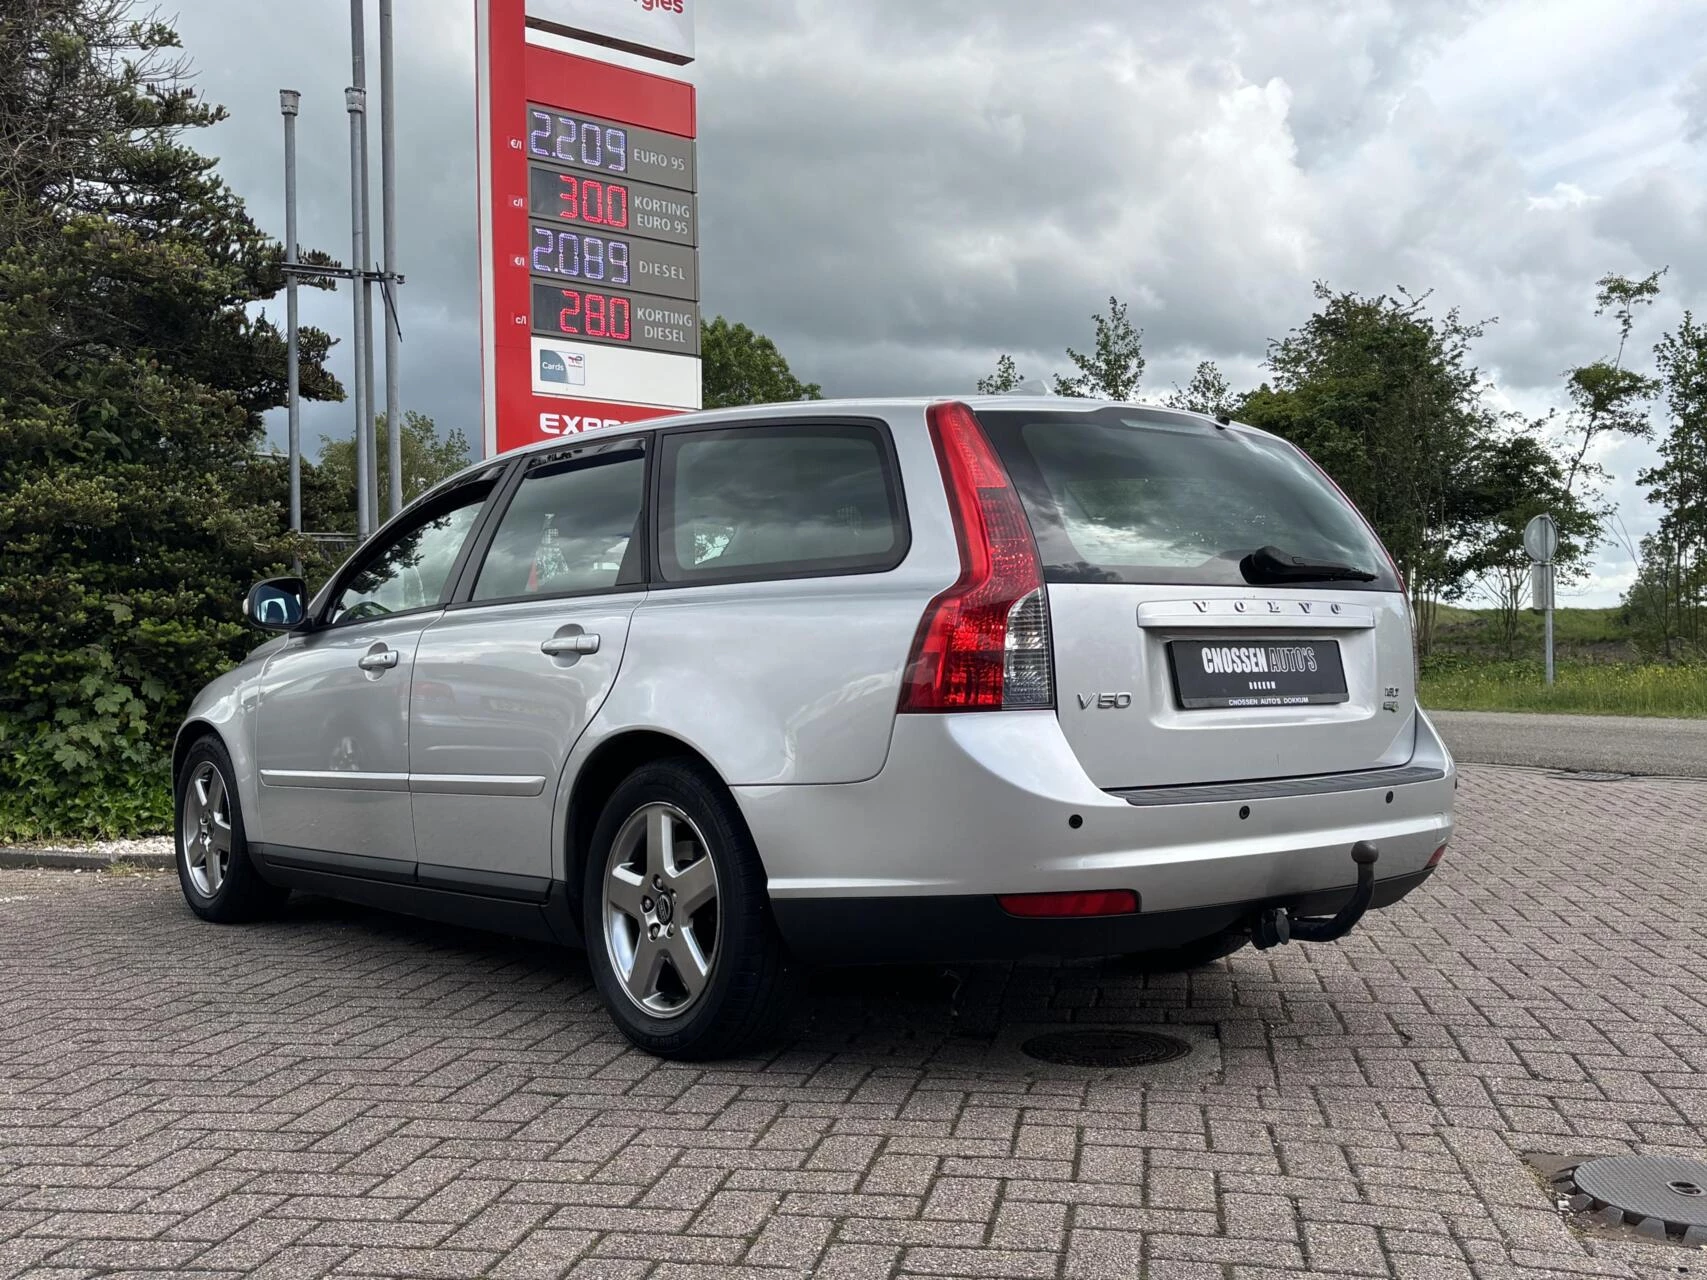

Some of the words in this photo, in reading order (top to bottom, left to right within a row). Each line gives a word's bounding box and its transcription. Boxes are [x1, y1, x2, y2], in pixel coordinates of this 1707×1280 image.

[530, 111, 626, 171] 2.209
[634, 149, 668, 167] EURO
[671, 157, 685, 171] 95
[559, 174, 627, 228] 30.0
[634, 195, 690, 218] KORTING
[637, 216, 671, 231] EURO
[674, 222, 688, 235] 95
[533, 228, 628, 284] 2.089
[639, 260, 686, 281] DIESEL
[560, 290, 630, 340] 28.0
[637, 307, 693, 327] KORTING
[644, 325, 686, 344] DIESEL
[542, 361, 565, 371] Cards
[1192, 600, 1343, 615] VOLVO
[1201, 647, 1268, 674] CNOSSEN
[1269, 646, 1318, 673] AUTO'S
[1077, 691, 1132, 710] V50
[1228, 698, 1258, 706] CNOSSEN
[1260, 697, 1282, 705] AUTO'S
